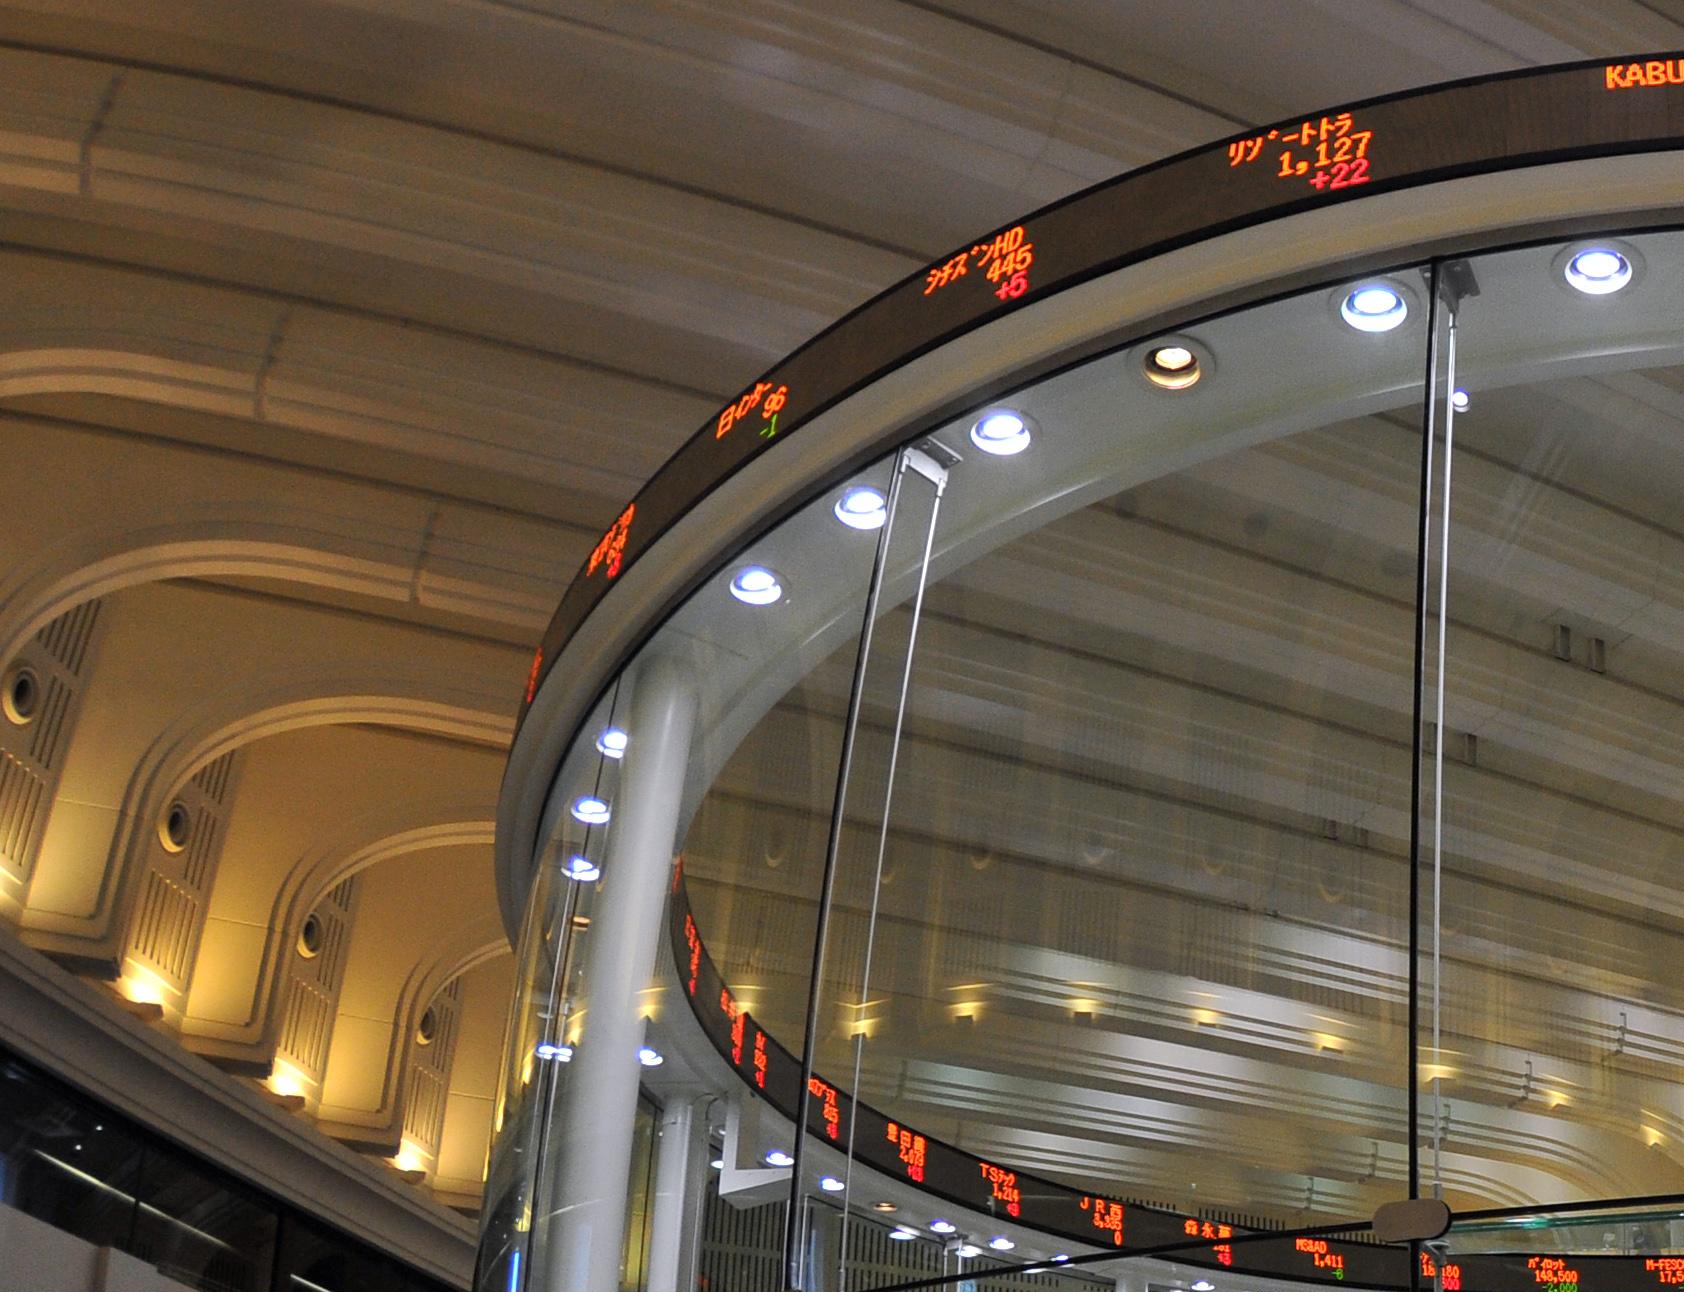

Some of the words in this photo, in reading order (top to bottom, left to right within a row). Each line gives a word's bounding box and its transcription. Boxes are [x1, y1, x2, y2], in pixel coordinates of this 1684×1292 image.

[1278, 131, 1373, 178] 1,127
[1309, 158, 1371, 191] +22
[986, 243, 1033, 283] 445
[994, 269, 1029, 300] +5
[760, 413, 779, 439] -1
[1313, 1253, 1344, 1269] 1,411
[1534, 1270, 1579, 1283] 148,500
